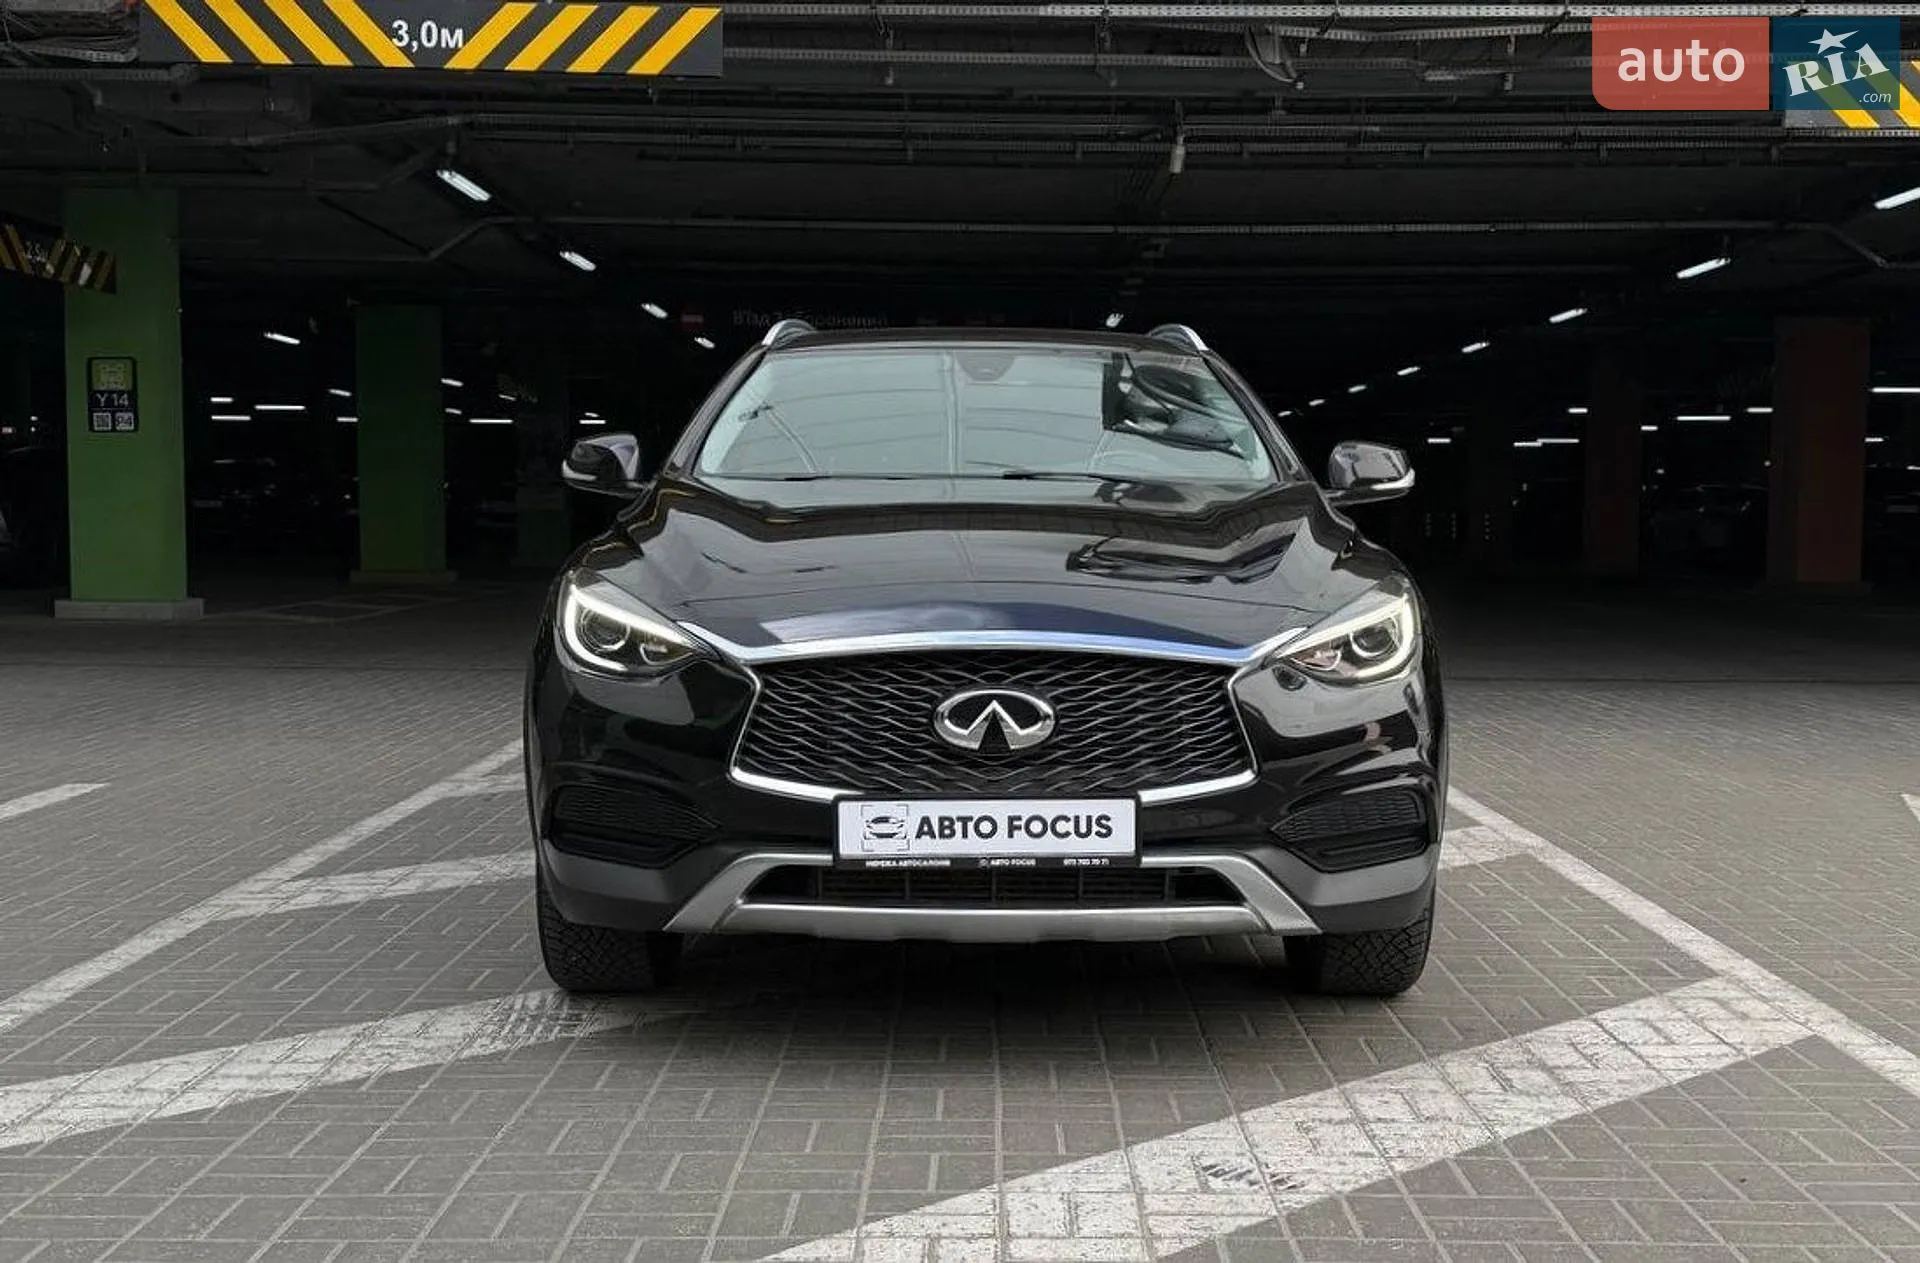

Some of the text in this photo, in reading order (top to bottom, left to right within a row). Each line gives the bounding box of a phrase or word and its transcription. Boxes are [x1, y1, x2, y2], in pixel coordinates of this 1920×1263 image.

[391, 19, 463, 53] 3,0м
[112, 392, 129, 408] 14
[915, 815, 1113, 839] АВТО FOCUS
